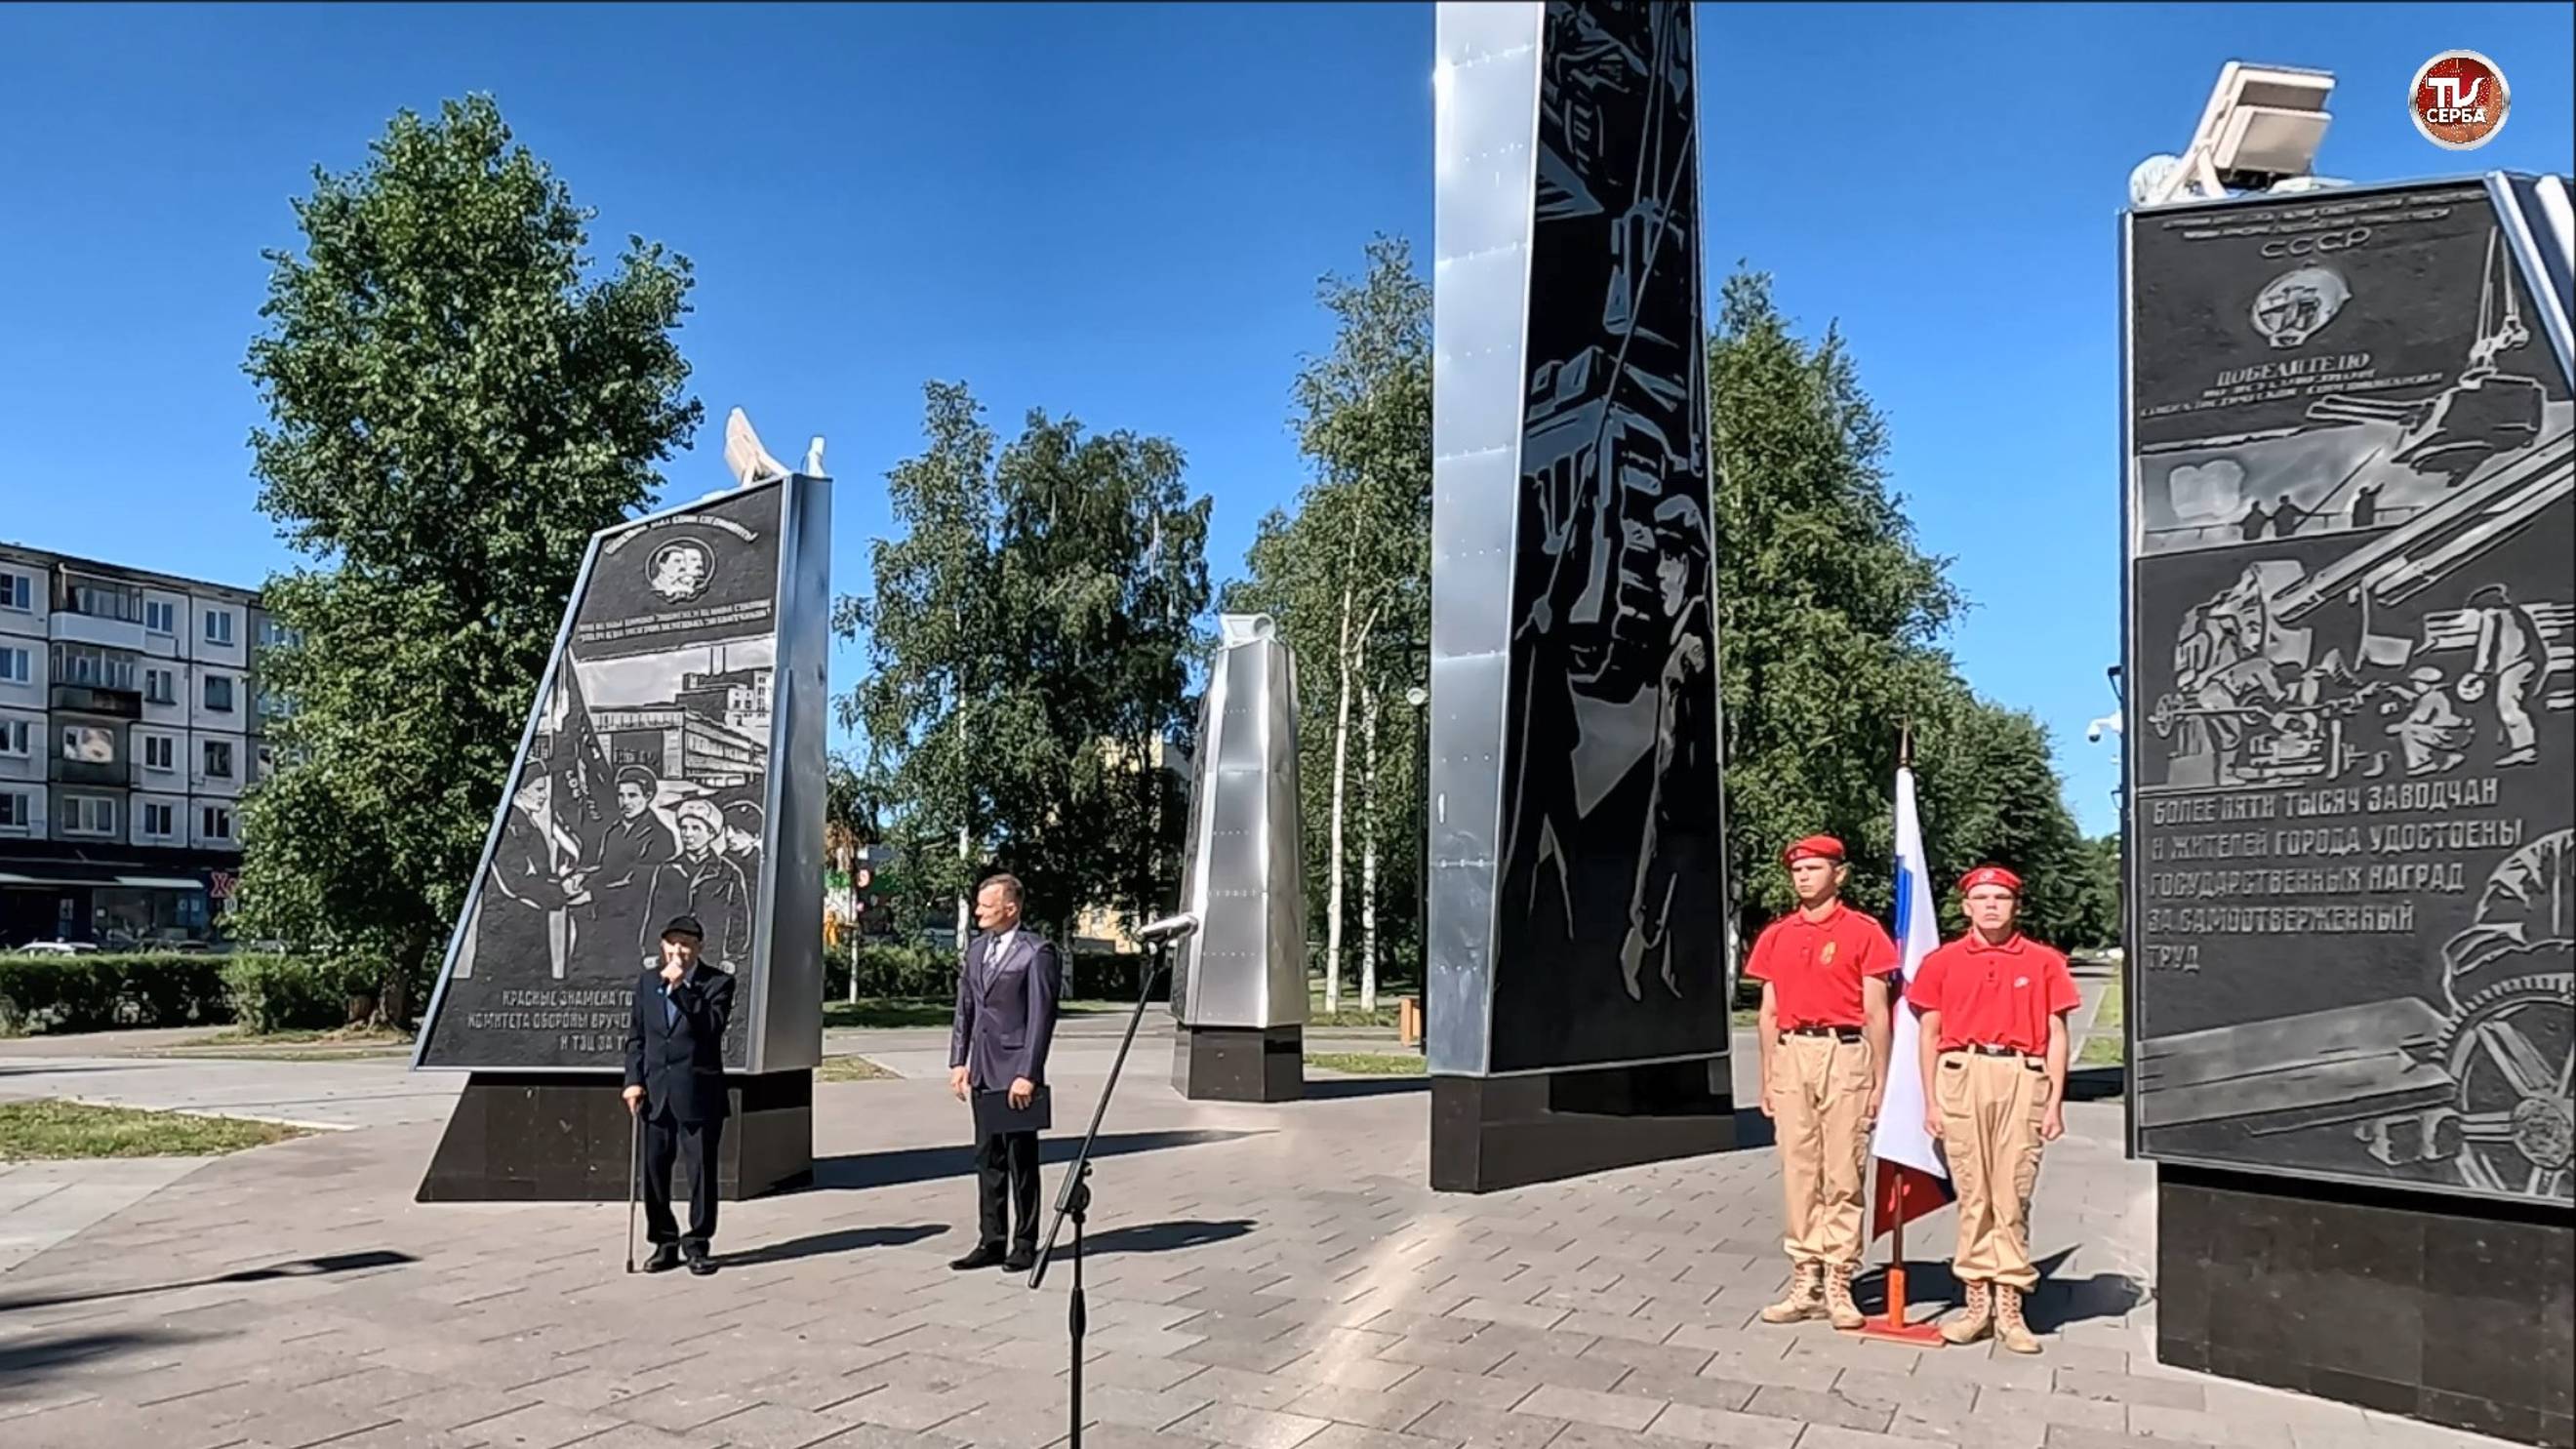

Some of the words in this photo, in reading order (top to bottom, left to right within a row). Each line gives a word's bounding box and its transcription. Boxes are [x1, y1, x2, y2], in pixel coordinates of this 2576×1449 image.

[2260, 226, 2372, 258] СССР
[2153, 799, 2216, 825] БОЛЕЕ
[2221, 794, 2275, 820] ПЯТИ
[2283, 787, 2360, 818] ТЫСЯЧ
[2367, 778, 2498, 812] ЗАВОДЧАН
[2170, 828, 2268, 859] ЖИТЕЛЕЙ
[2274, 826, 2361, 856] ГОРОДА
[2369, 819, 2522, 854] УДОСТОЕНЫ
[2149, 865, 2361, 899] ГОСУДАРСТВЕННЫХ
[2368, 863, 2466, 892] НАГРАД
[2148, 908, 2172, 933] ЗА
[2180, 900, 2414, 933] САМООТВЕРЖЕННЫЙ
[2147, 946, 2199, 971] ТРУД
[503, 990, 557, 1006] КРАСНЫЕ
[559, 990, 616, 1006] ЗНАМЕНА
[467, 1012, 529, 1028] КОМИТЕТА
[533, 1012, 588, 1028] ОБОРОНЫ
[573, 1035, 595, 1051] ТЭЦ
[598, 1035, 613, 1051] ЗА
